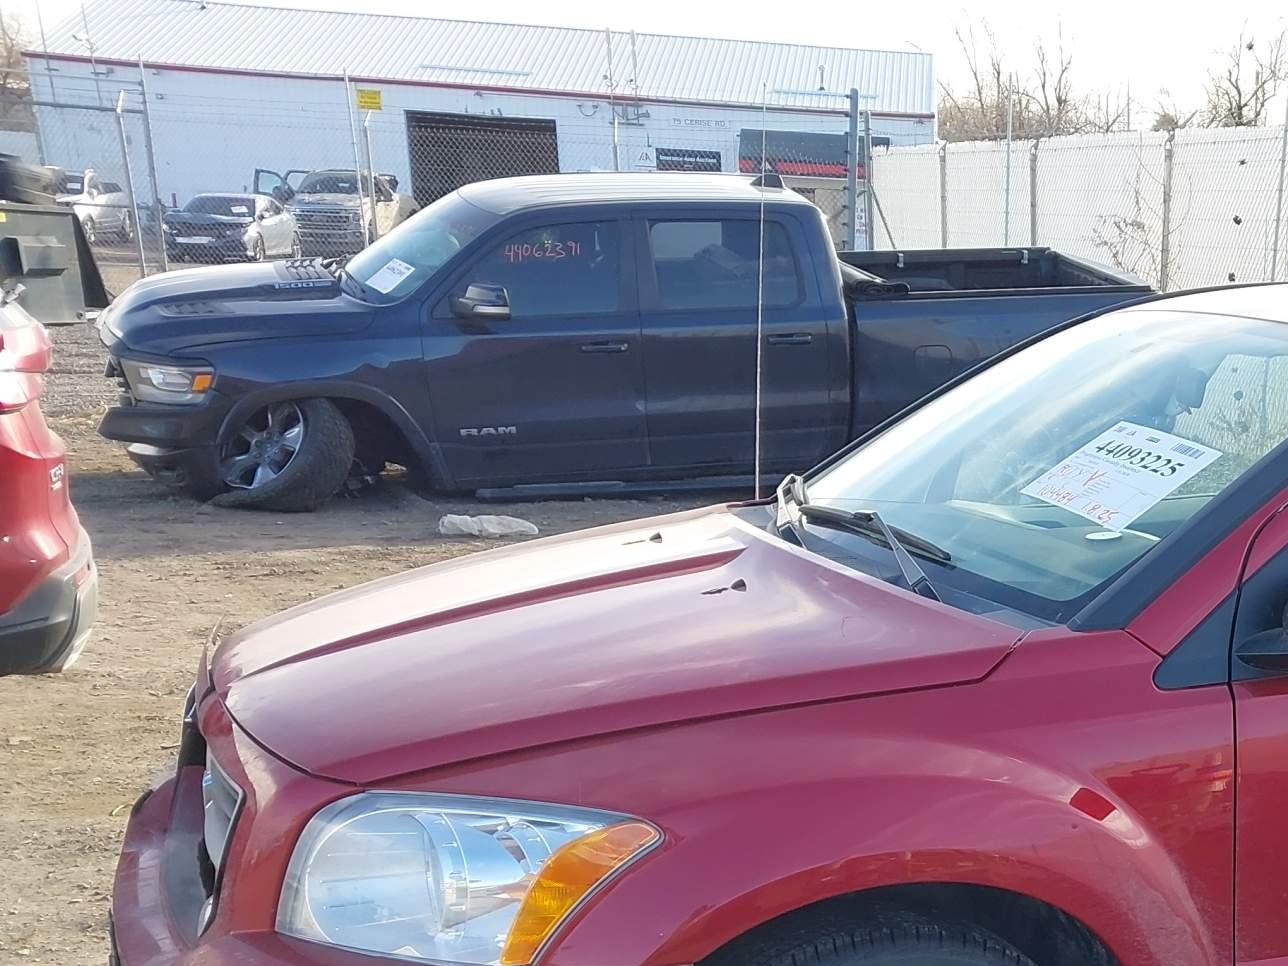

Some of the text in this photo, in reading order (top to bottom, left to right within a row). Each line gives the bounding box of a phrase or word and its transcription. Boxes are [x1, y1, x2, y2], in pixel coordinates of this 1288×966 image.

[504, 241, 581, 263] 44062391
[459, 426, 517, 436] RAM
[1095, 439, 1185, 477] 44093225
